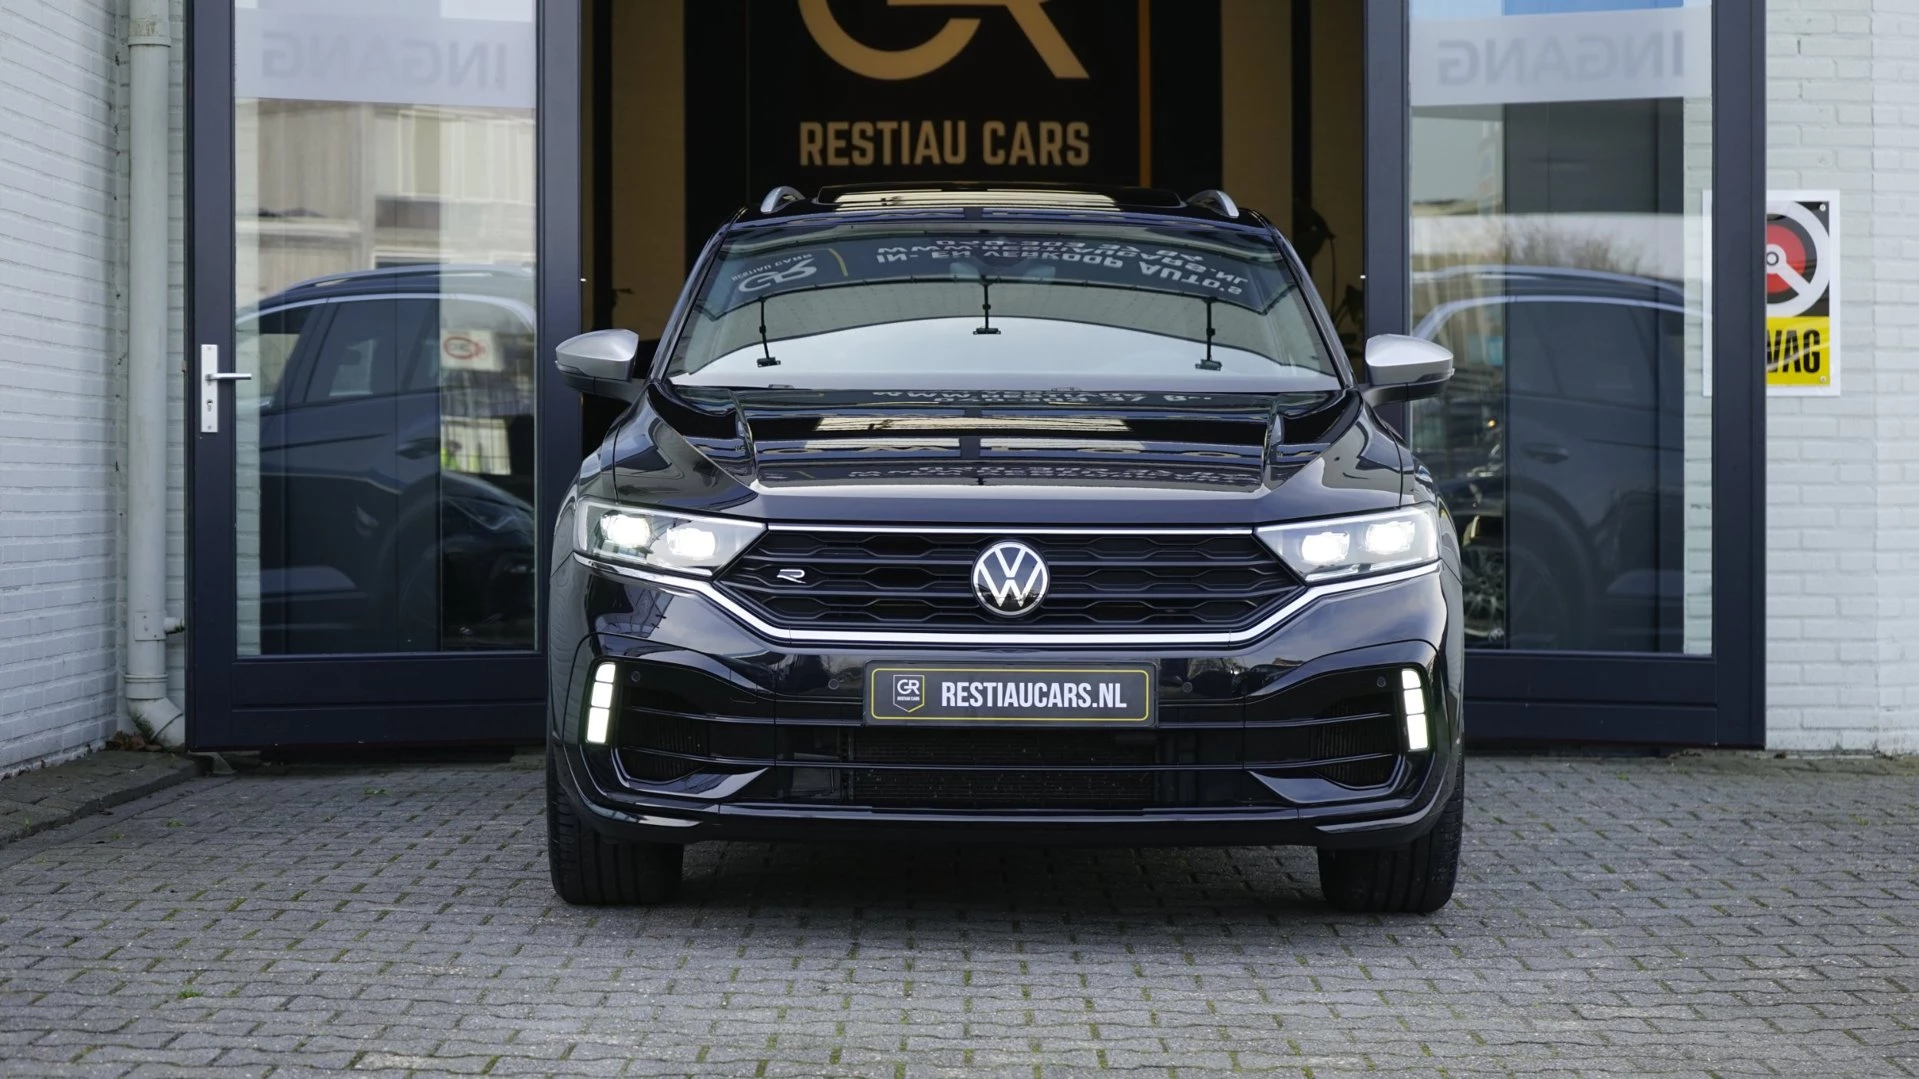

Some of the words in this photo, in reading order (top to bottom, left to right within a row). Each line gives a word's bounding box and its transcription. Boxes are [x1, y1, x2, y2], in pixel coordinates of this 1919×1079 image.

[799, 119, 967, 166] RESTIAU
[982, 120, 1090, 166] CARS
[777, 569, 806, 584] R
[897, 679, 920, 695] GR
[941, 681, 1128, 708] RESTIAUCARS.NL
